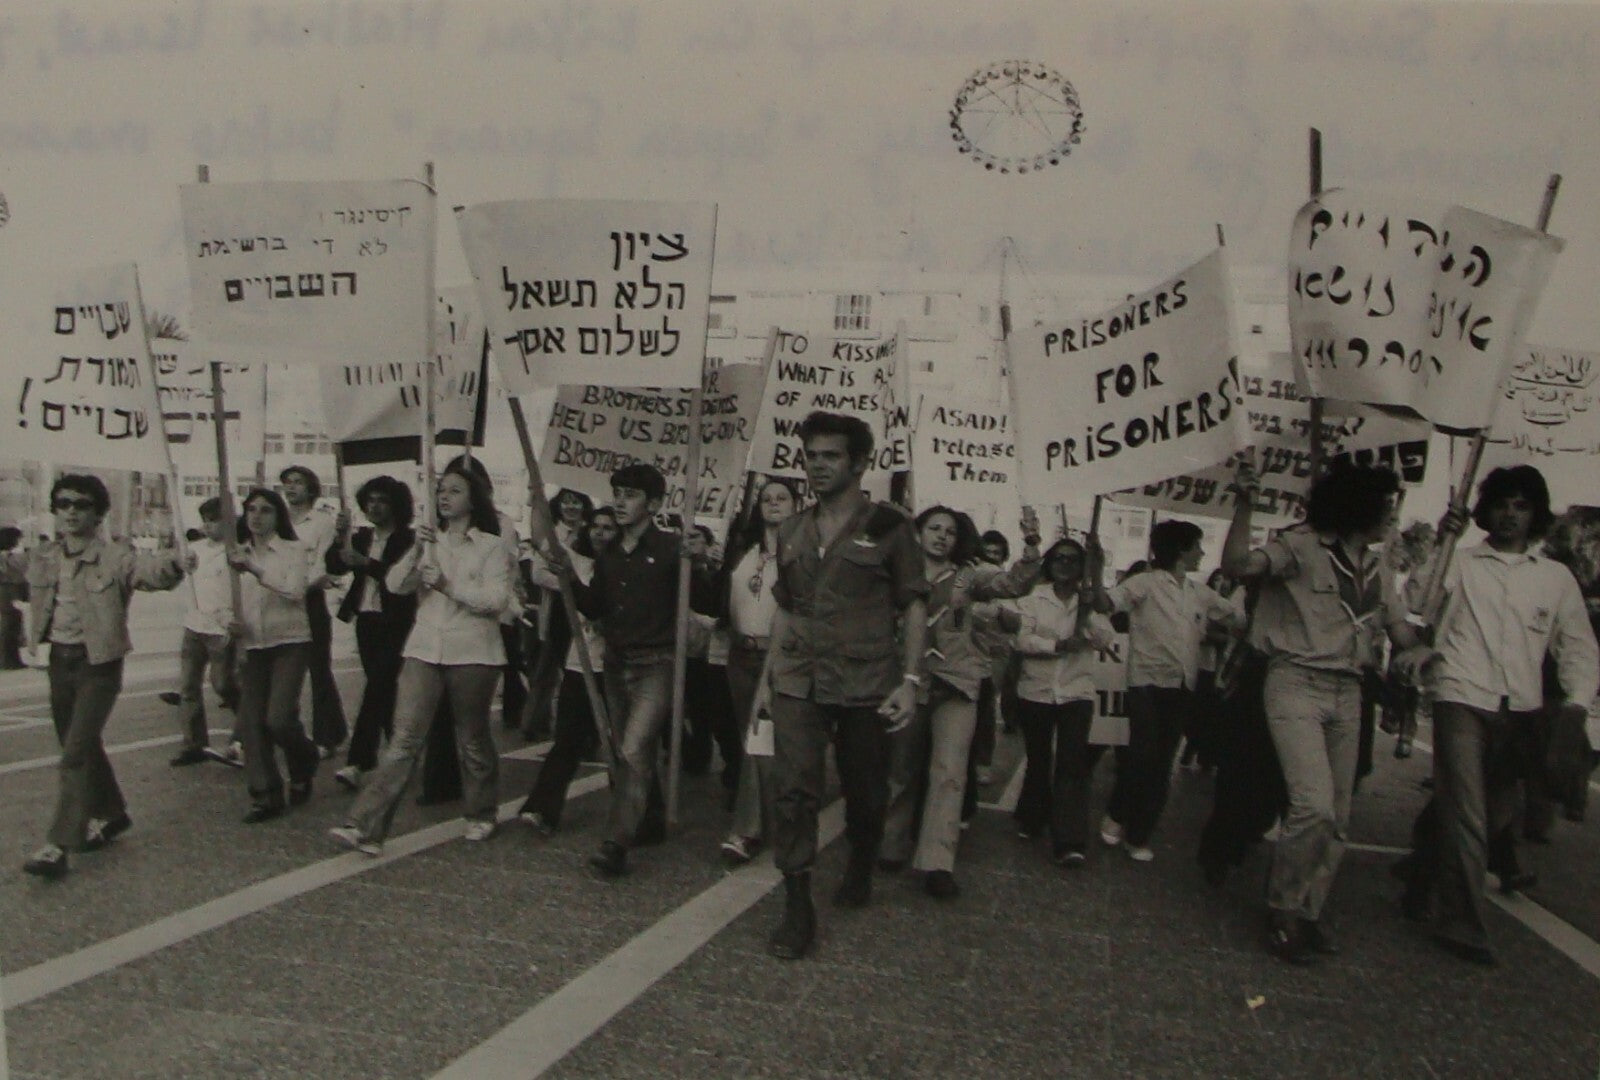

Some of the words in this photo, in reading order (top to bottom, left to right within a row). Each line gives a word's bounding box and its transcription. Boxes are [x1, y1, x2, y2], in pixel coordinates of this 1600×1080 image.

[198, 237, 288, 258] ברשימת
[358, 237, 389, 257] לא
[610, 231, 690, 272] ציון
[224, 272, 357, 303] השבויים
[614, 264, 687, 311] הלא
[578, 313, 681, 357] לשלום
[779, 332, 809, 354] TO
[44, 357, 141, 389] תמורת
[778, 360, 834, 387] WHAT
[1096, 352, 1164, 404] FOR
[776, 391, 801, 408] OF
[812, 394, 879, 411] NAMES
[549, 402, 607, 434] HELP
[618, 416, 653, 443] US
[932, 406, 1008, 434] ASAD!
[944, 461, 1009, 484] Them
